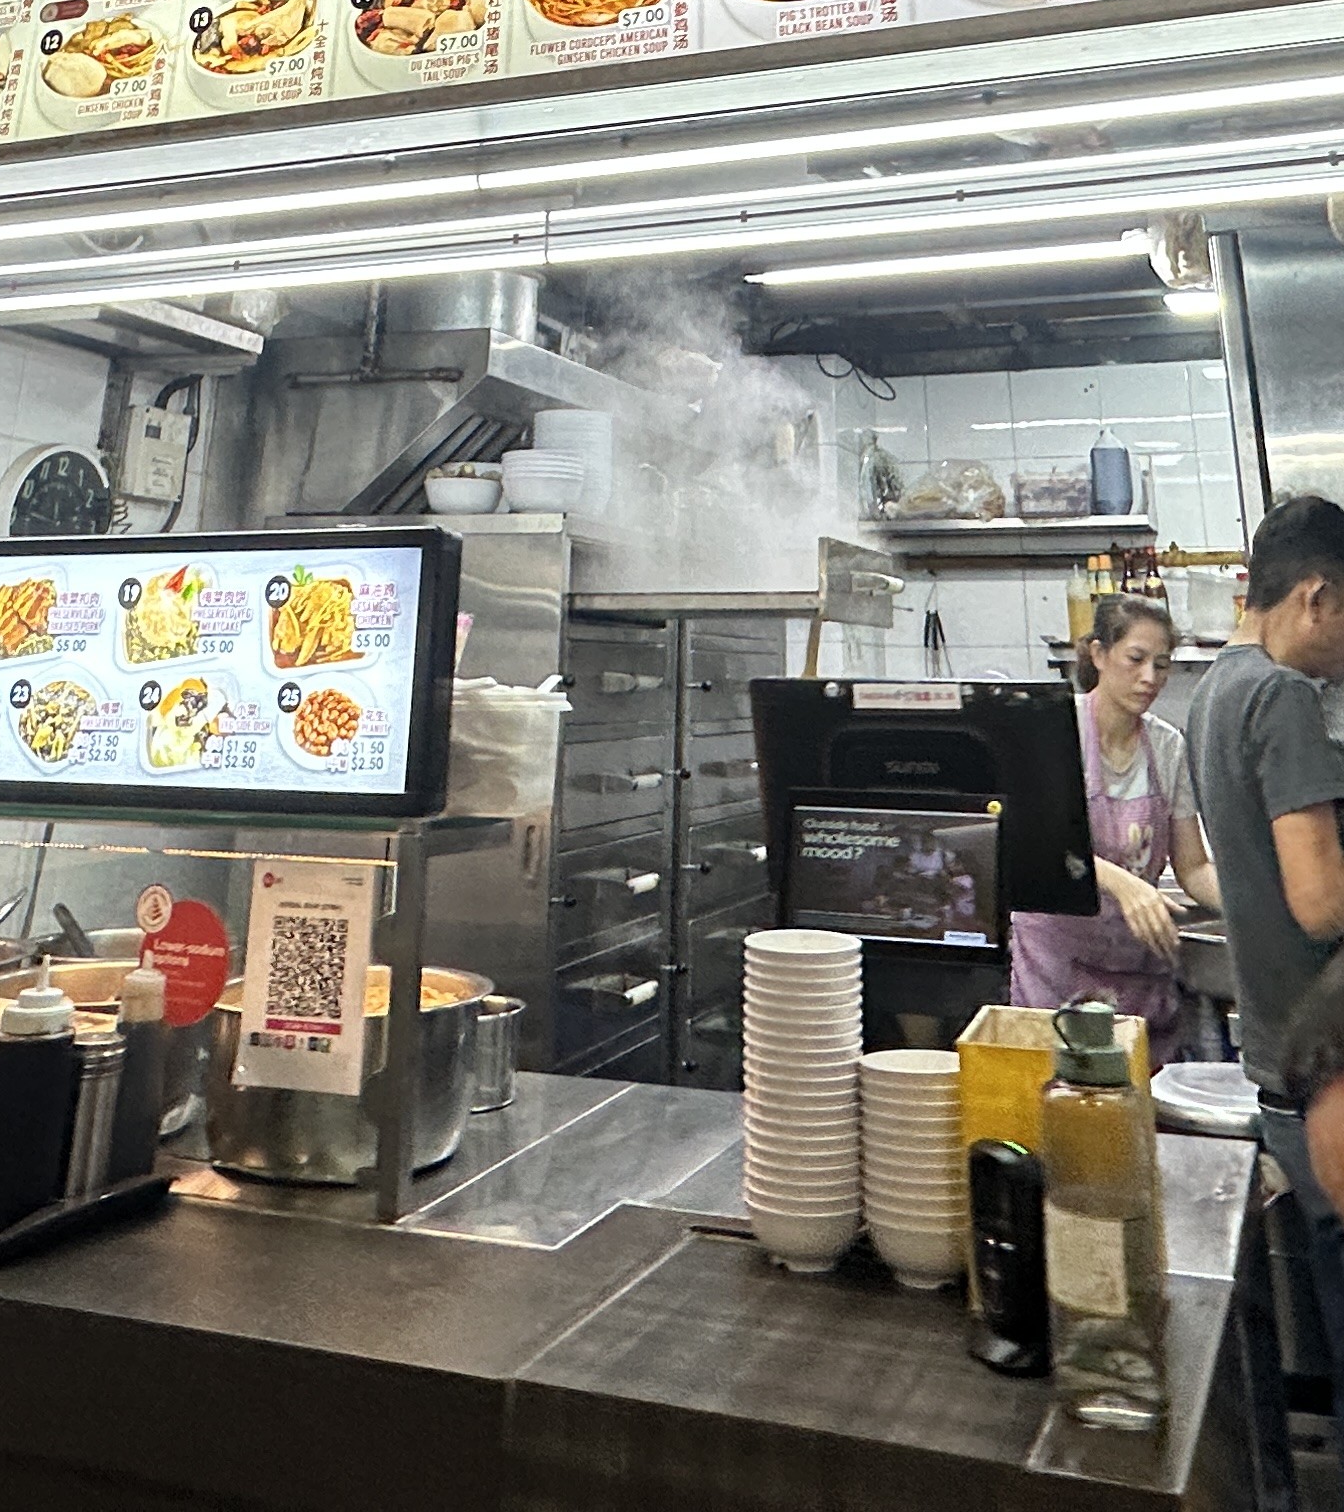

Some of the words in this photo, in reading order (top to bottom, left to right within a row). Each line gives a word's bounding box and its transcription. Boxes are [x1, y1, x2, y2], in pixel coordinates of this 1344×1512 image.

[622, 8, 664, 27] $7.00
[810, 2, 855, 18] TROTTER
[193, 12, 209, 28] 13
[779, 23, 813, 37] BLACK
[815, 18, 843, 31] BEAN
[846, 13, 874, 28] SOUP
[45, 35, 60, 51] 12
[439, 34, 478, 53] $7.00
[530, 41, 566, 56] FLOWER
[619, 28, 668, 44] AMERICAN
[558, 51, 597, 65] GINSENG
[599, 44, 640, 59] CHICKEN
[643, 40, 669, 54] SOUP
[269, 58, 305, 75] $7.00
[424, 56, 454, 69] ZHONG
[423, 71, 441, 82] TAIL
[443, 68, 467, 80] SOUP
[114, 80, 146, 95] $7.00
[229, 80, 270, 95] ASSORTED
[272, 76, 303, 90] HERBAL
[257, 92, 277, 103] DUCK
[280, 88, 303, 101] SOUP
[58, 456, 70, 477] 12
[85, 489, 94, 508] 2
[123, 584, 141, 602] 19
[269, 581, 289, 601] 20
[56, 639, 87, 653] $5.00
[201, 640, 234, 654] $5.00
[356, 634, 390, 647] $5.00
[12, 685, 30, 702] 23
[141, 686, 160, 704] 24
[281, 688, 300, 706] 25
[90, 735, 119, 747] $1.50
[226, 740, 257, 754] $1.50
[352, 741, 384, 755] $1.50
[88, 749, 117, 762] $2.50
[224, 755, 255, 769] $2.50
[351, 757, 384, 771] $2.50
[802, 831, 901, 848] wholesome
[799, 846, 864, 860] mood?
